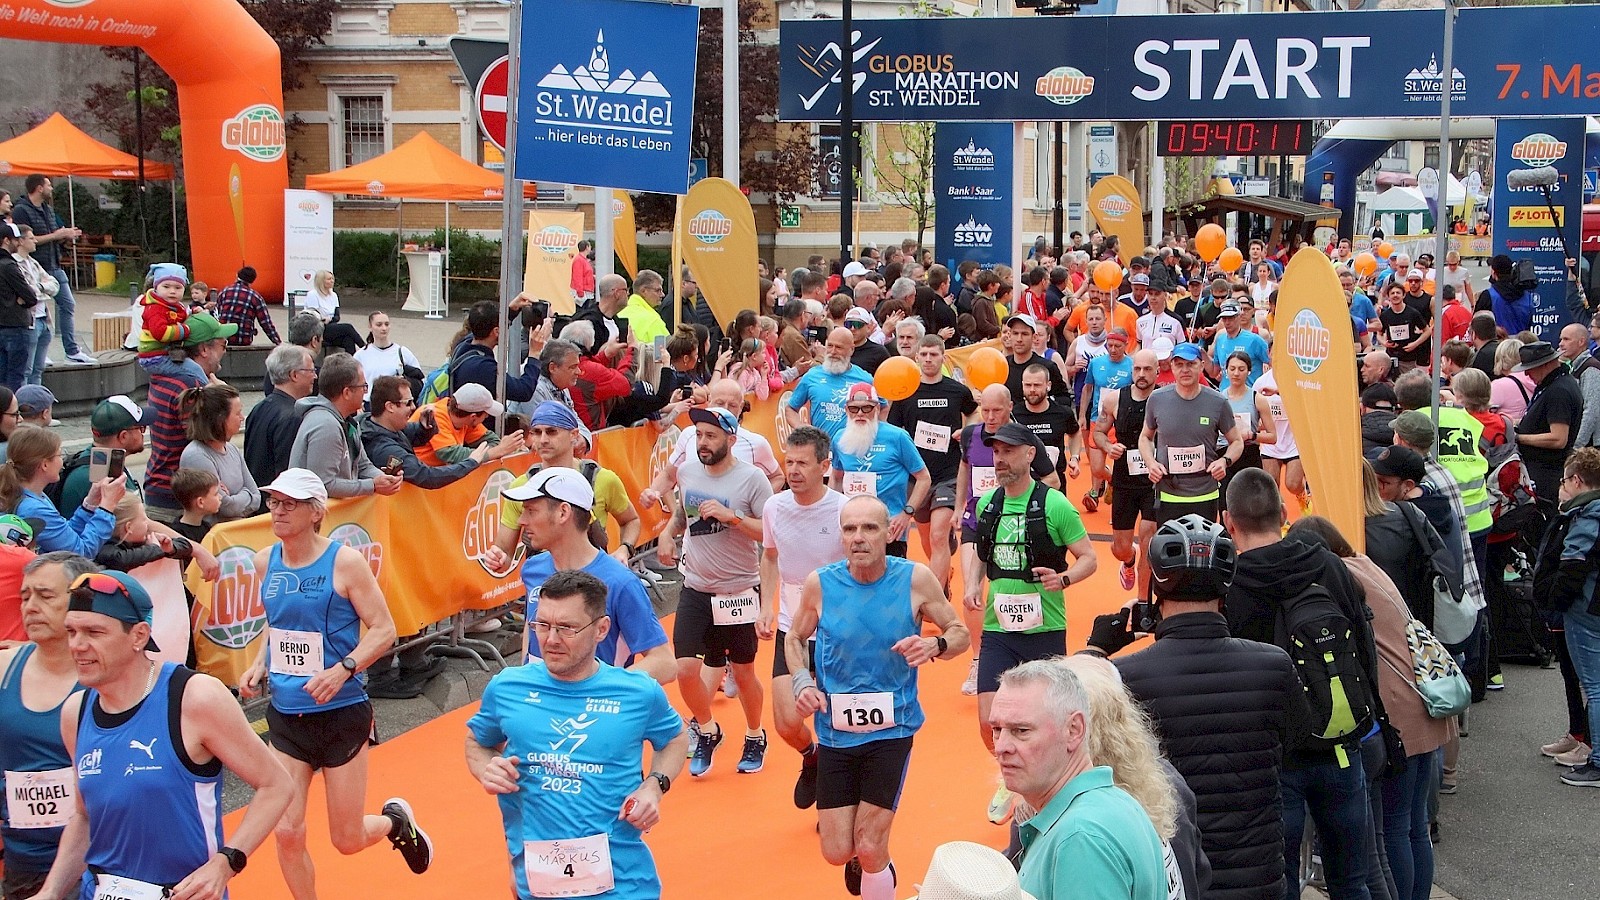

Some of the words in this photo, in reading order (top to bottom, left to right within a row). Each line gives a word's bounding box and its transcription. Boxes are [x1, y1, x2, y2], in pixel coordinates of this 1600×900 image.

[17, 7, 50, 26] Welt
[49, 14, 84, 30] noch
[84, 16, 99, 31] in
[101, 18, 158, 39] Ordnung.
[869, 55, 954, 73] GLOBUS
[1131, 37, 1371, 101] START
[896, 72, 1019, 90] MARATHON
[1036, 75, 1094, 95] Globus
[1496, 64, 1530, 99] 7.
[869, 90, 895, 106] ST.
[900, 90, 980, 106] WENDEL
[226, 116, 285, 146] Globus
[1167, 123, 1300, 152] 09:40:11
[548, 129, 574, 143] hier
[578, 131, 603, 146] lebt
[606, 134, 629, 148] das
[632, 136, 671, 151] Leben
[1513, 141, 1566, 159] Globus
[1099, 199, 1131, 211] Globus
[690, 216, 731, 234] Globus
[533, 231, 578, 247] Globus
[954, 231, 992, 242] SSW
[1532, 314, 1559, 326] urger
[1288, 321, 1328, 358] Globus
[850, 484, 867, 492] 3:45
[719, 597, 754, 610] DOMINIK
[999, 603, 1034, 614] CARSTEN
[731, 608, 743, 617] 61
[1010, 614, 1024, 623] 78
[280, 641, 310, 655] BERND
[285, 655, 305, 667] 113
[585, 703, 620, 714] GLAAB
[843, 708, 884, 727] 130
[527, 752, 571, 764] GLOBUS
[15, 784, 70, 801] MICHAEL
[541, 776, 582, 795] 2023
[27, 802, 58, 815] 102
[538, 850, 601, 866] MARKUS
[563, 864, 575, 878] 4
